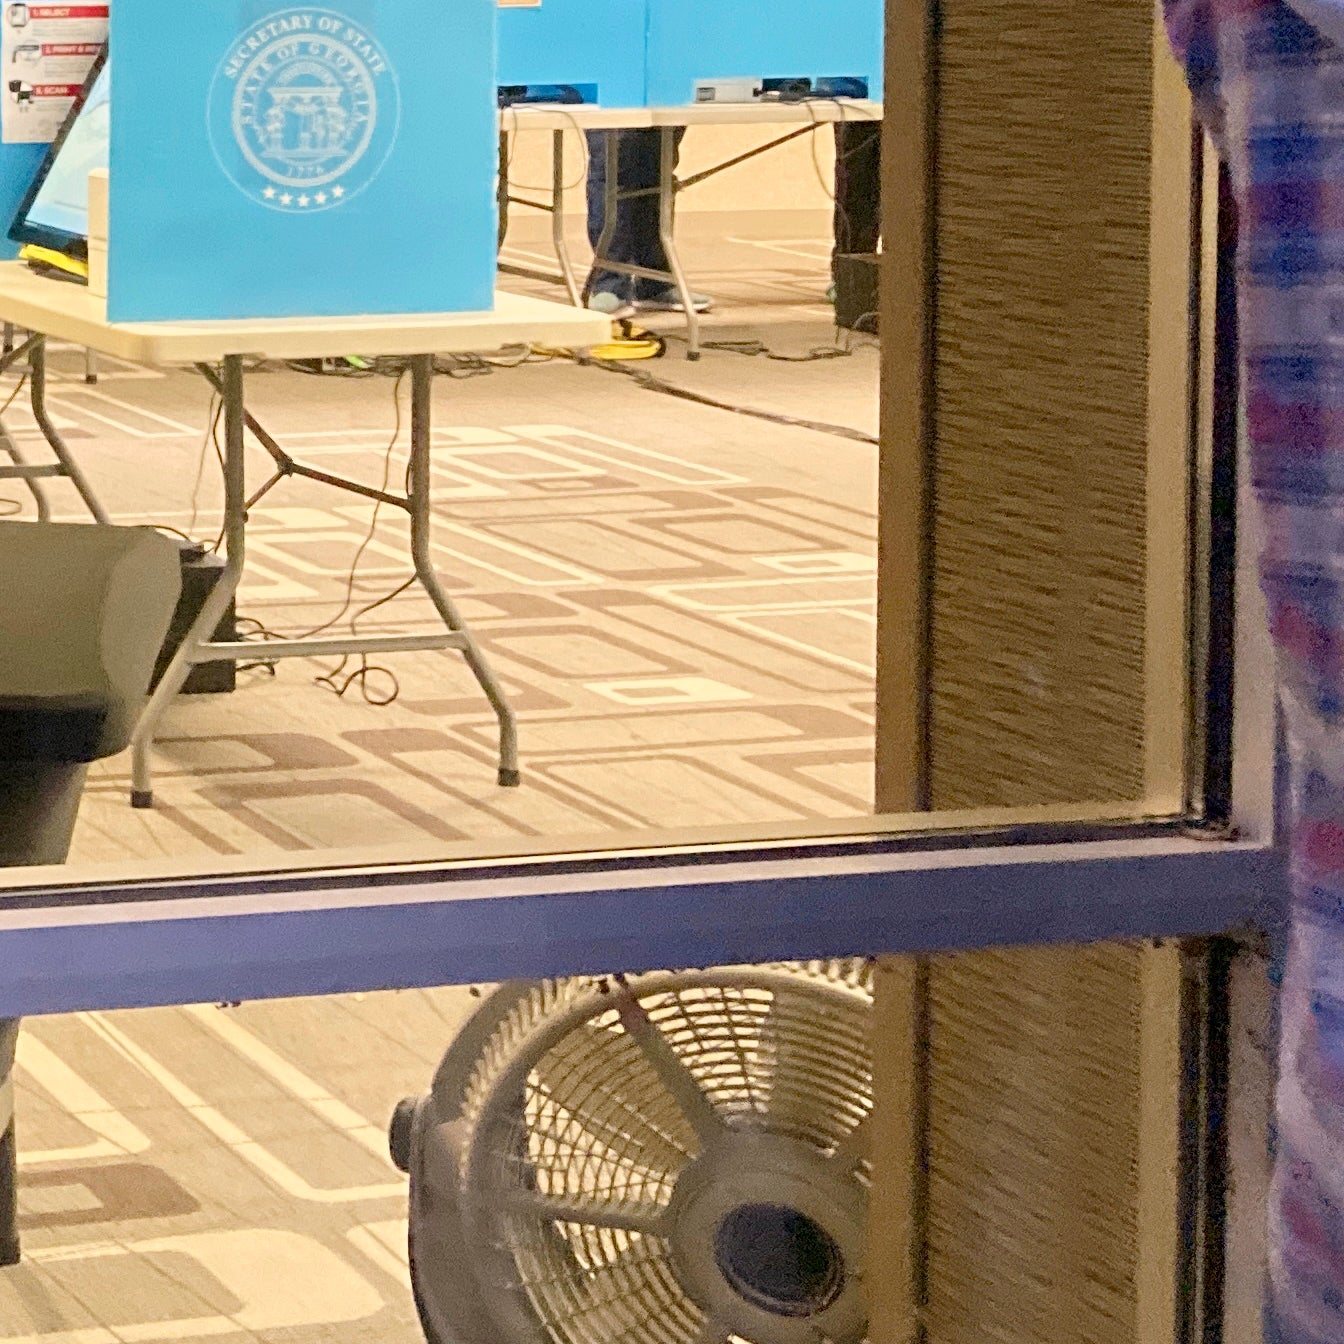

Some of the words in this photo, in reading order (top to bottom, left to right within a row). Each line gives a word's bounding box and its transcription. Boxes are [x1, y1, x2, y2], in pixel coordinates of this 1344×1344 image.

[224, 14, 312, 79] SECRETARY
[318, 16, 343, 33] OF
[344, 27, 387, 76] STATE
